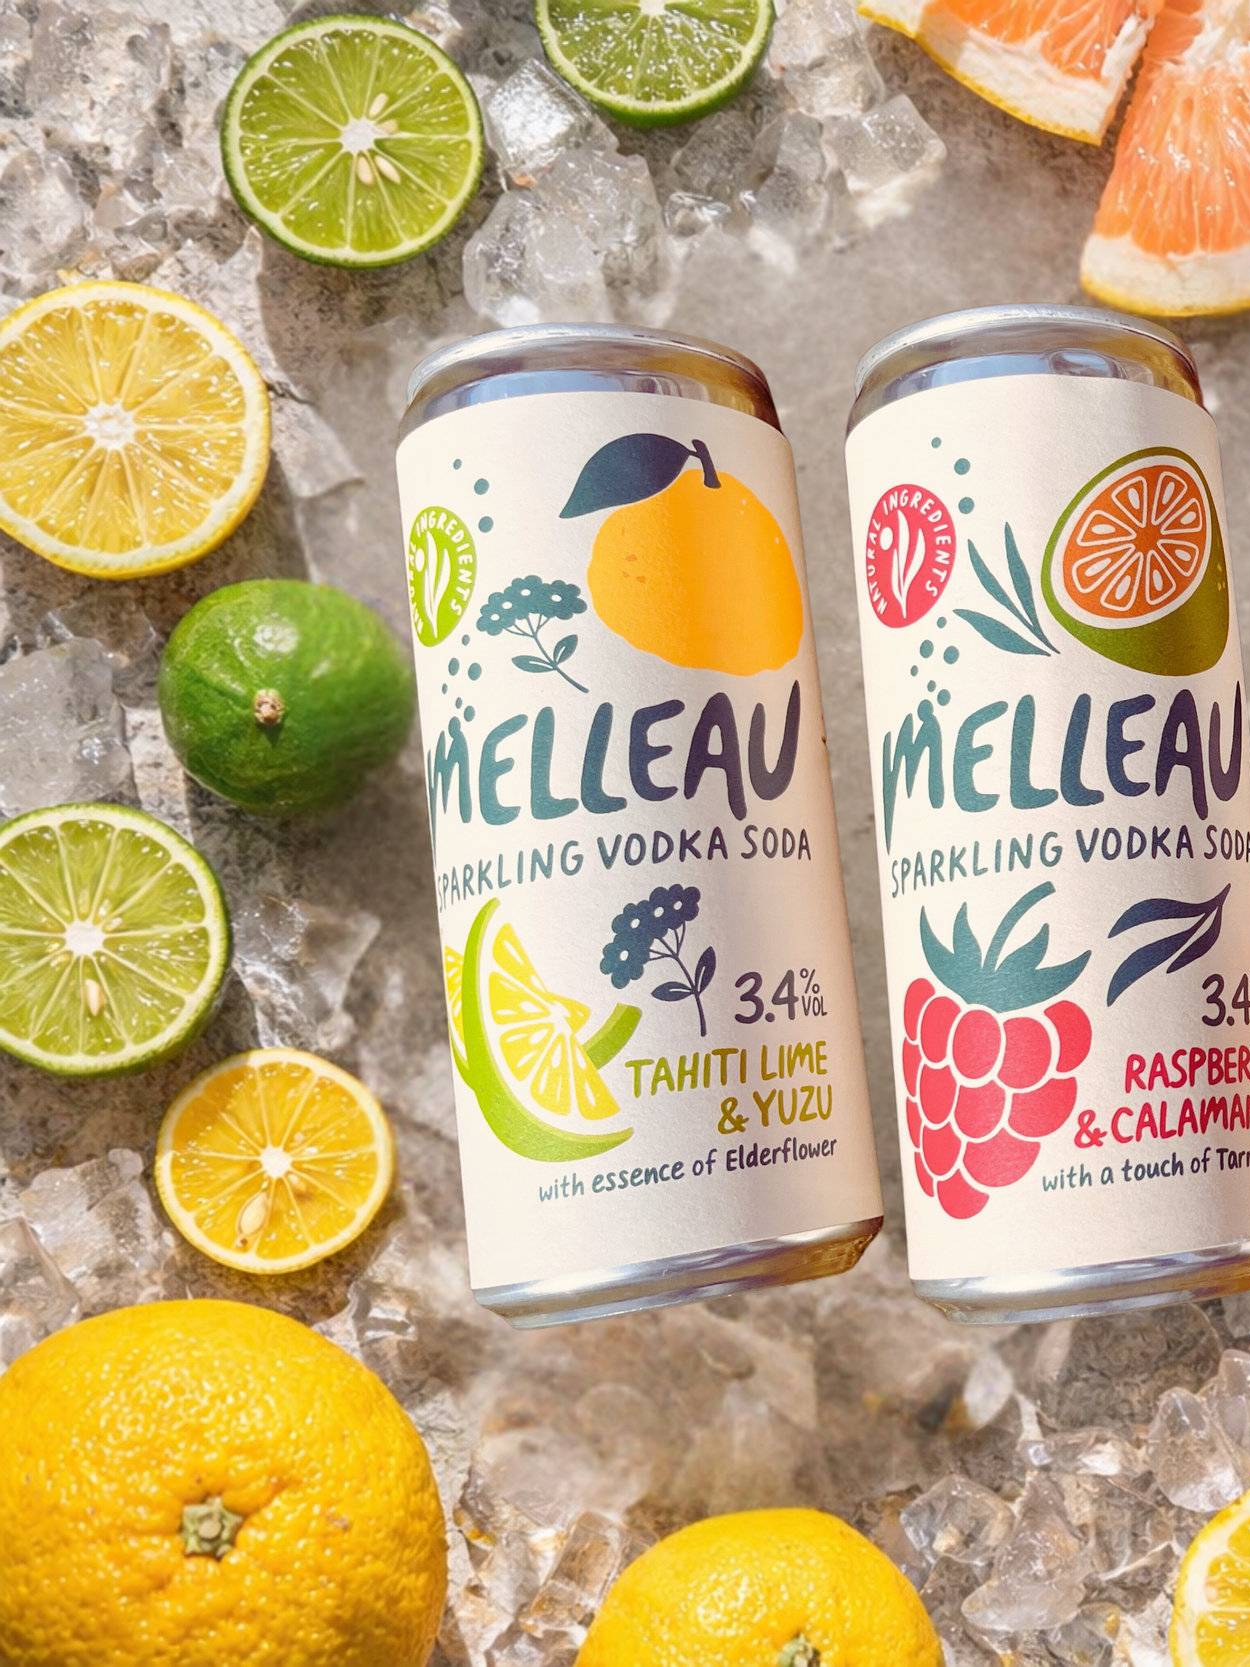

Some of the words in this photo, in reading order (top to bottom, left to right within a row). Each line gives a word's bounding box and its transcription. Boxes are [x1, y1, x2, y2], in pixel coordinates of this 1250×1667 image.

[416, 511, 473, 616] INGREDIENTS
[867, 518, 888, 615] NATURAL
[883, 488, 952, 598] INGREDIENTS
[427, 680, 801, 869] MELLEAU
[882, 680, 1242, 856] MELLEAU
[437, 840, 584, 913] SPARKLING
[597, 826, 728, 869] VODKA
[741, 824, 812, 860] SODA
[891, 831, 1063, 898] SPARKLING
[1076, 825, 1194, 863] VODKA
[801, 995, 828, 1017] VOL
[625, 1047, 747, 1098] TAHITI
[761, 1040, 828, 1081] LIME
[717, 1096, 750, 1134] &
[753, 1084, 832, 1127] YUZU
[1074, 1109, 1108, 1149] &
[538, 1172, 585, 1202] with
[592, 1160, 684, 1194] essence
[692, 1148, 718, 1177] of
[726, 1137, 838, 1172] Elderflower
[1042, 1163, 1093, 1192] with
[1100, 1166, 1114, 1185] a
[1121, 1152, 1184, 1182] touch
[1190, 1146, 1211, 1174] of
